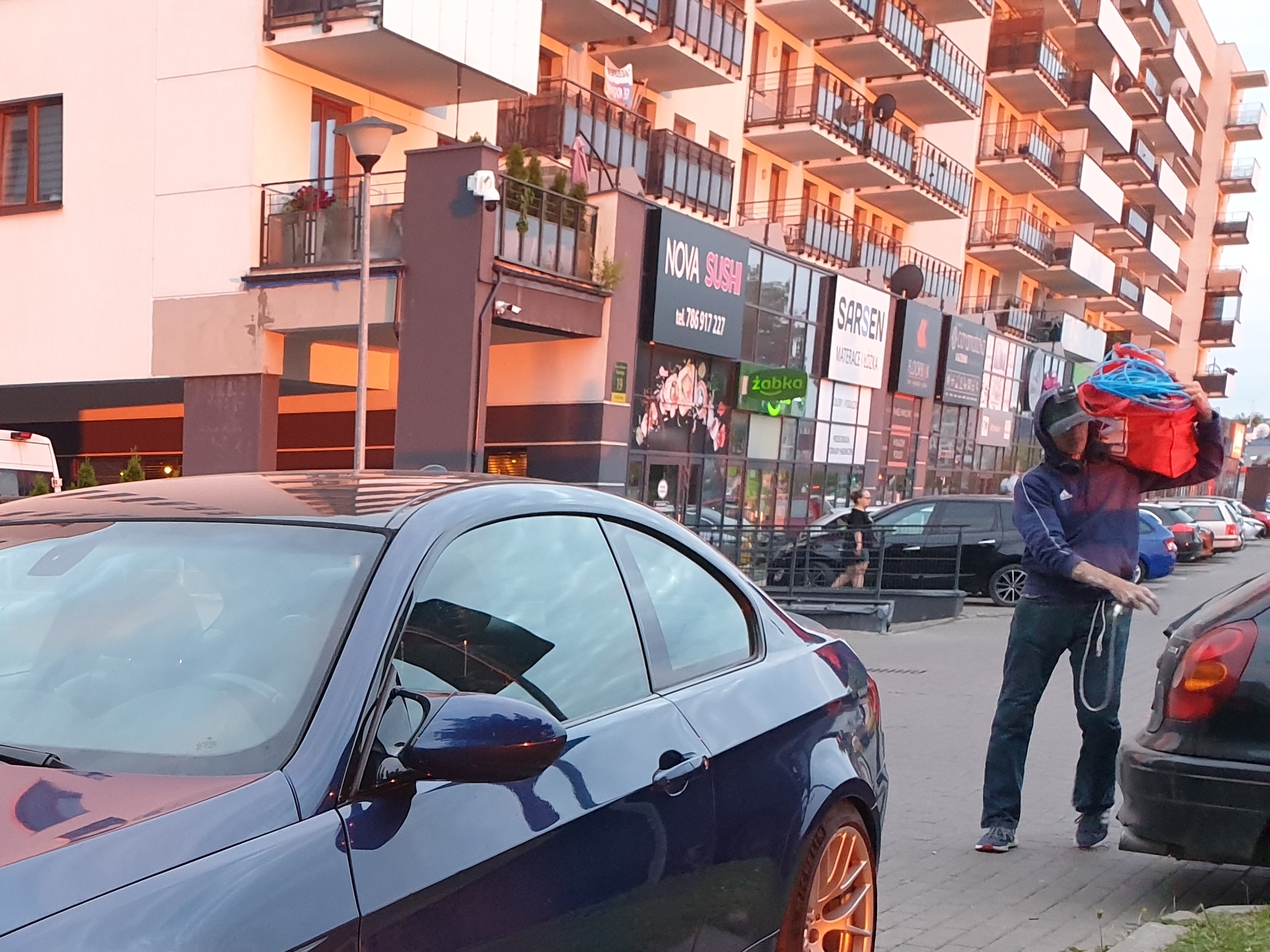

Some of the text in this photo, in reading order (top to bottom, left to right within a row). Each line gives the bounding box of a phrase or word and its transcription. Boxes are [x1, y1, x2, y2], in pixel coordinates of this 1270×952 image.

[665, 236, 743, 296] NOVA SUSHI
[686, 306, 699, 330] 786
[699, 310, 713, 333] 917
[837, 296, 885, 342] SARSEN
[835, 345, 862, 367] MATERACE
[752, 375, 803, 390] żabka
